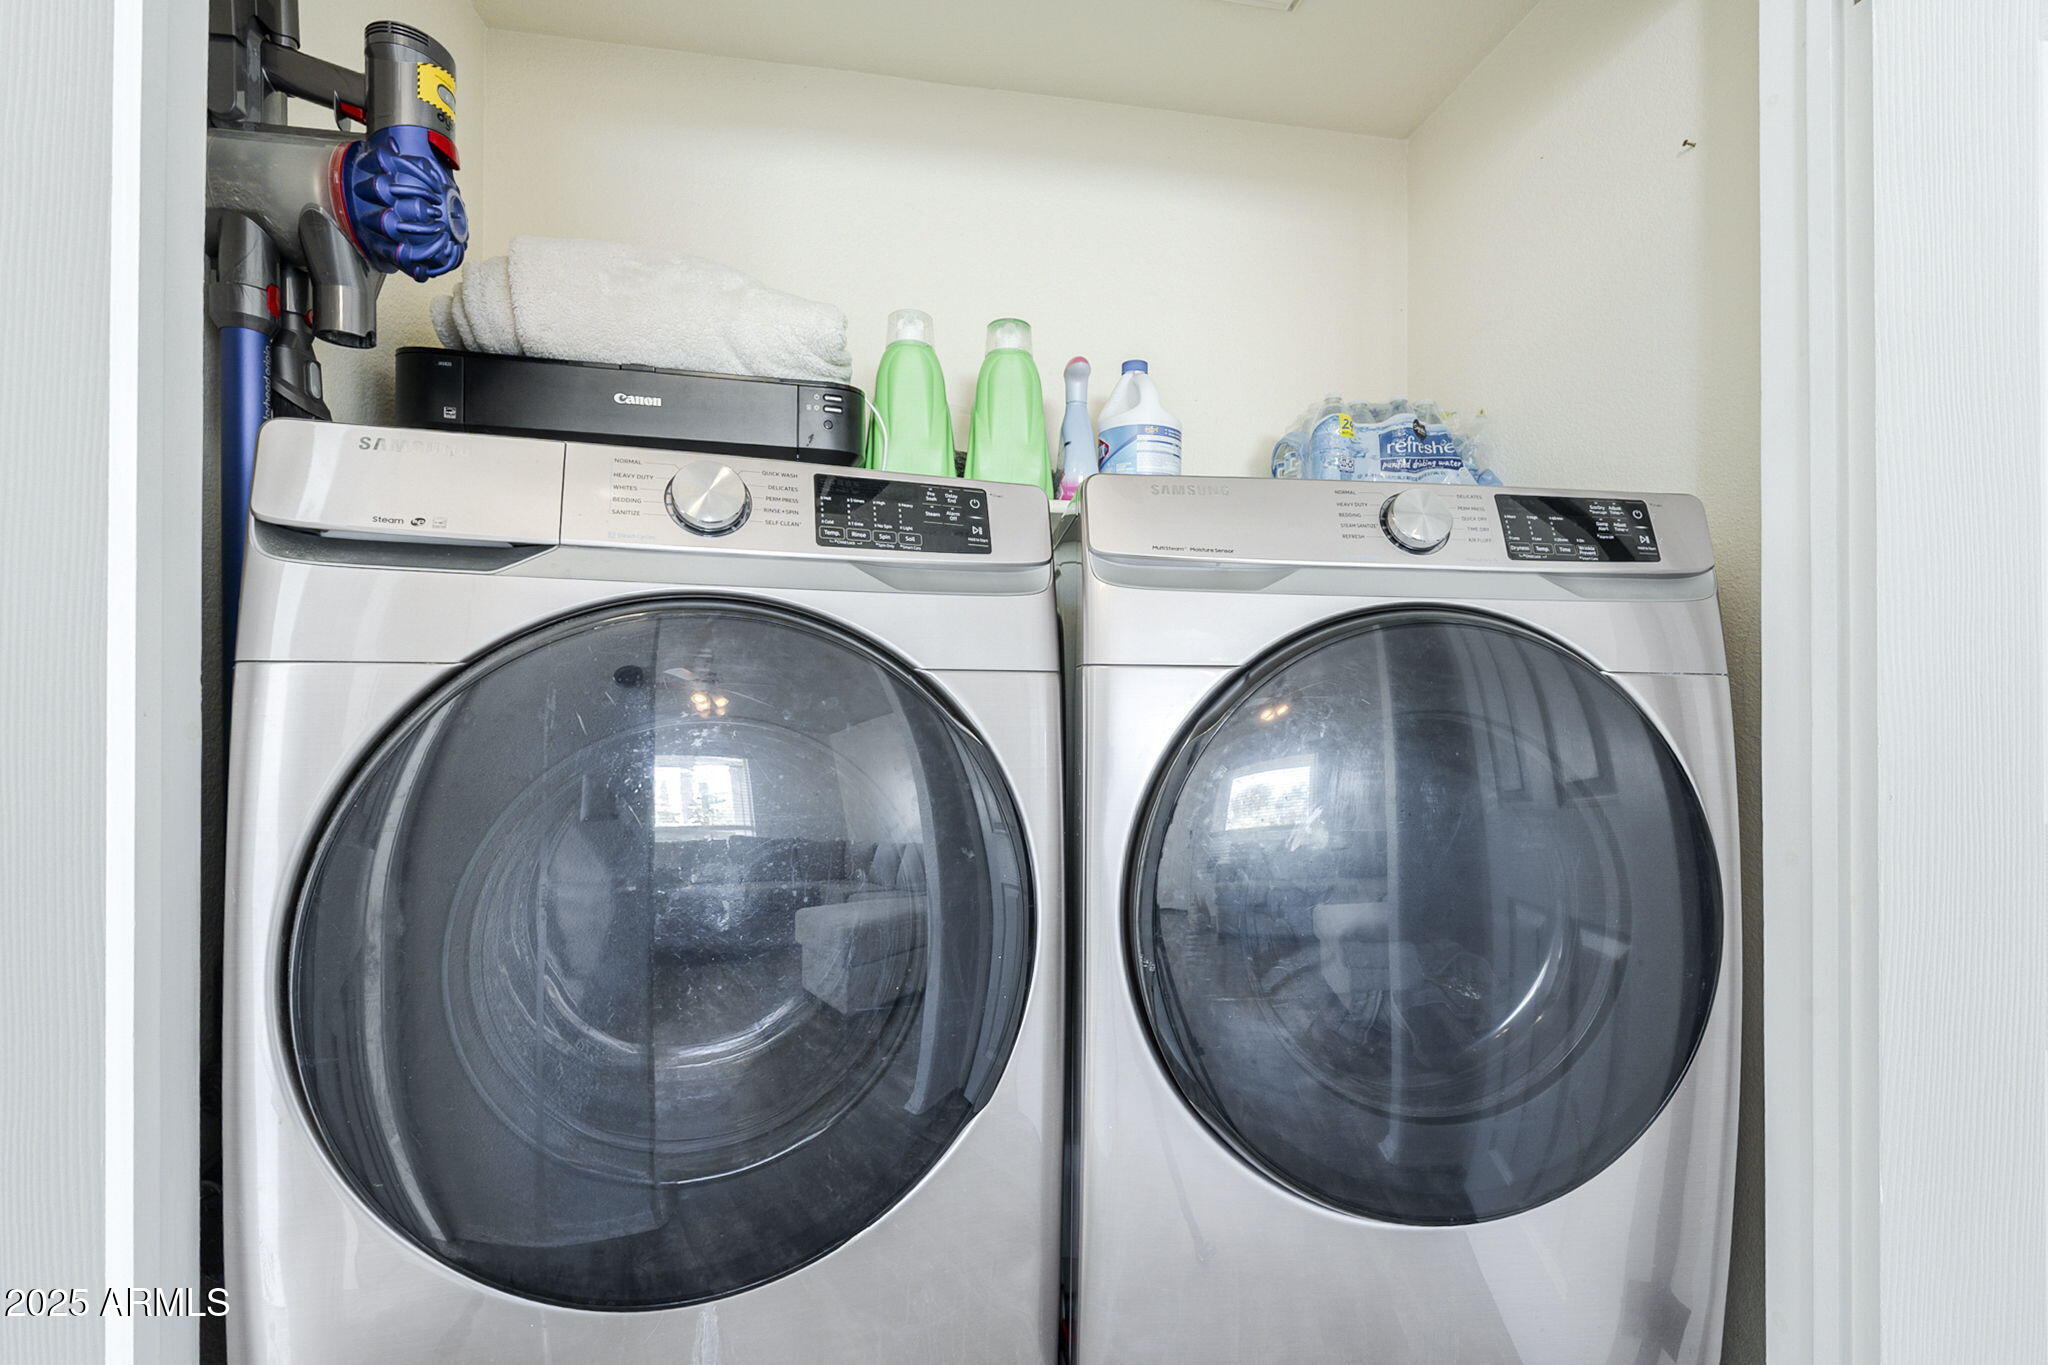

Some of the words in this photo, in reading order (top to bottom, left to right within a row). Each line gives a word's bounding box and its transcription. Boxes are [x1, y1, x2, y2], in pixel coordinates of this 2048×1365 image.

[613, 392, 662, 406] Canon
[1150, 484, 1230, 496] SAMSUNG
[372, 515, 404, 525] Steam
